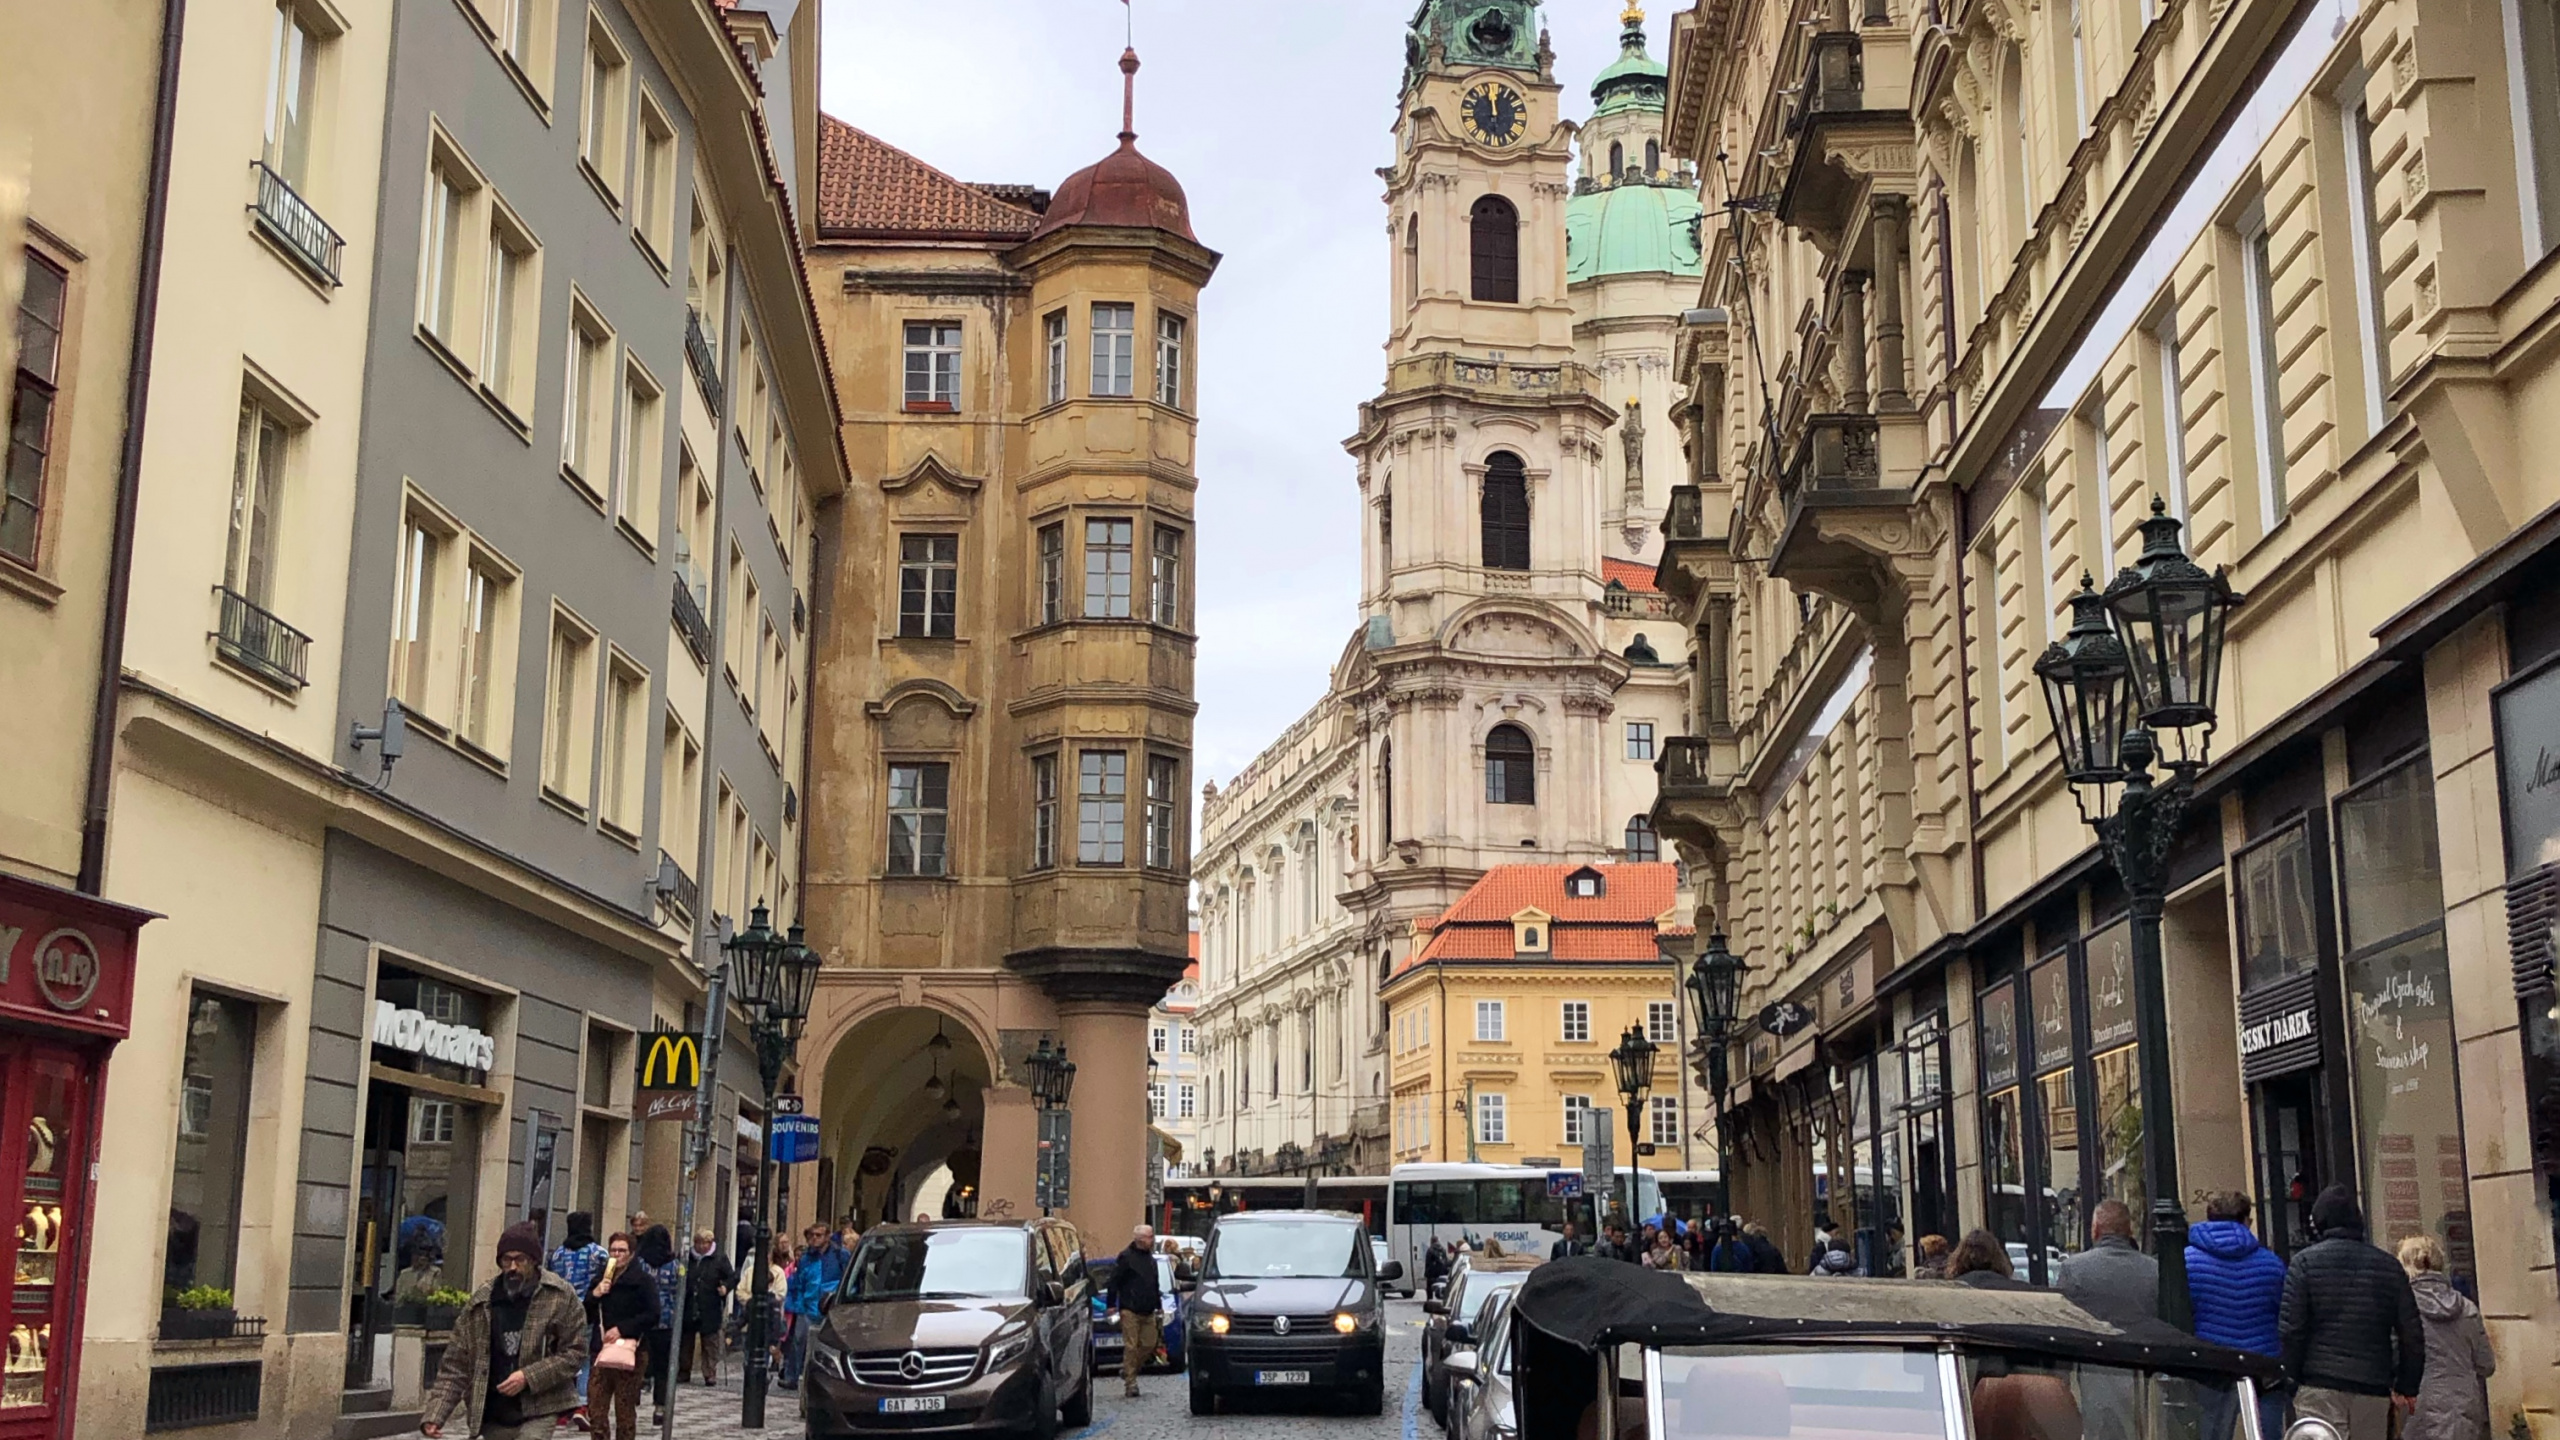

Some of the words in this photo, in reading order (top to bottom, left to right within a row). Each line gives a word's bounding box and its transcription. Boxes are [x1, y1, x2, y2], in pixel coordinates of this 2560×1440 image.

[2273, 1009, 2312, 1045] DÁREK
[373, 1000, 494, 1072] McDonald's
[649, 1095, 697, 1113] McCaf
[777, 1099, 791, 1111] WC
[772, 1120, 819, 1135] SOUVENIRS
[1493, 1231, 1529, 1241] PREMIANT
[887, 1400, 906, 1412] 6AT
[914, 1398, 941, 1411] 3136
